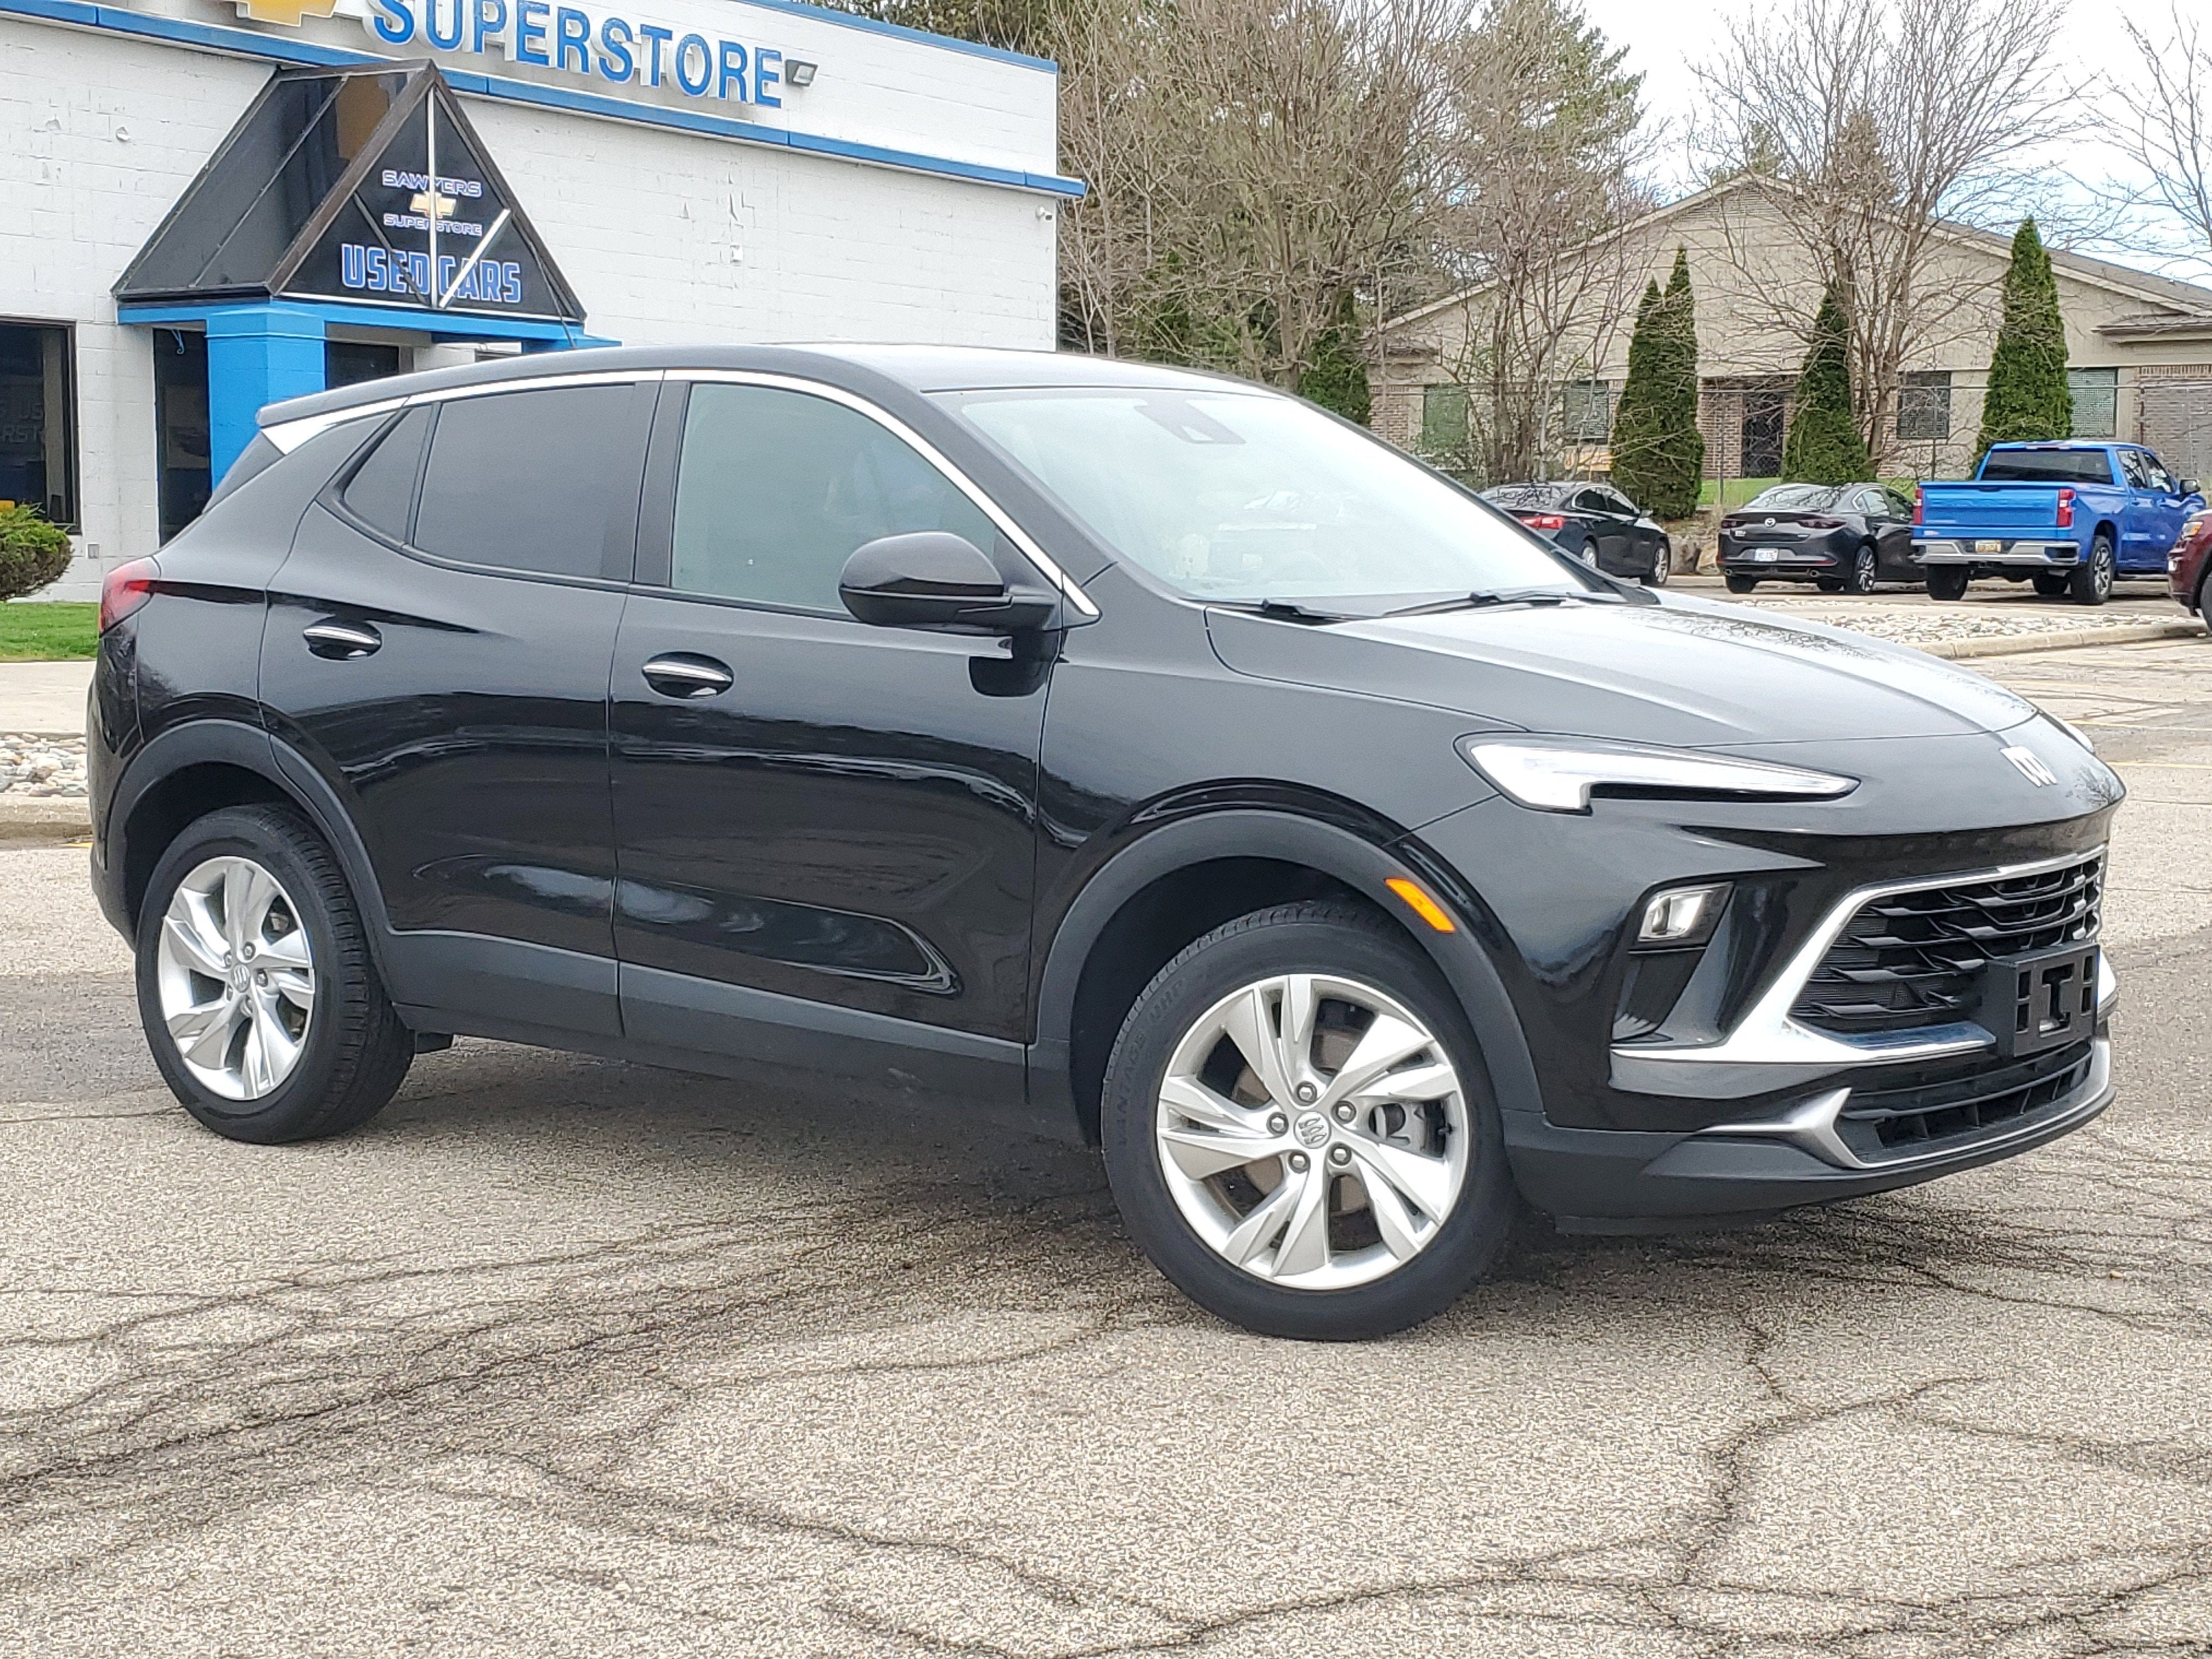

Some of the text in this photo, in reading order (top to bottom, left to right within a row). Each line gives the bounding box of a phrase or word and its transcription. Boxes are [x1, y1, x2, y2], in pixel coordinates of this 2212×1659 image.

[373, 0, 782, 109] SUPERSTORE
[341, 243, 521, 303] USED CARS
